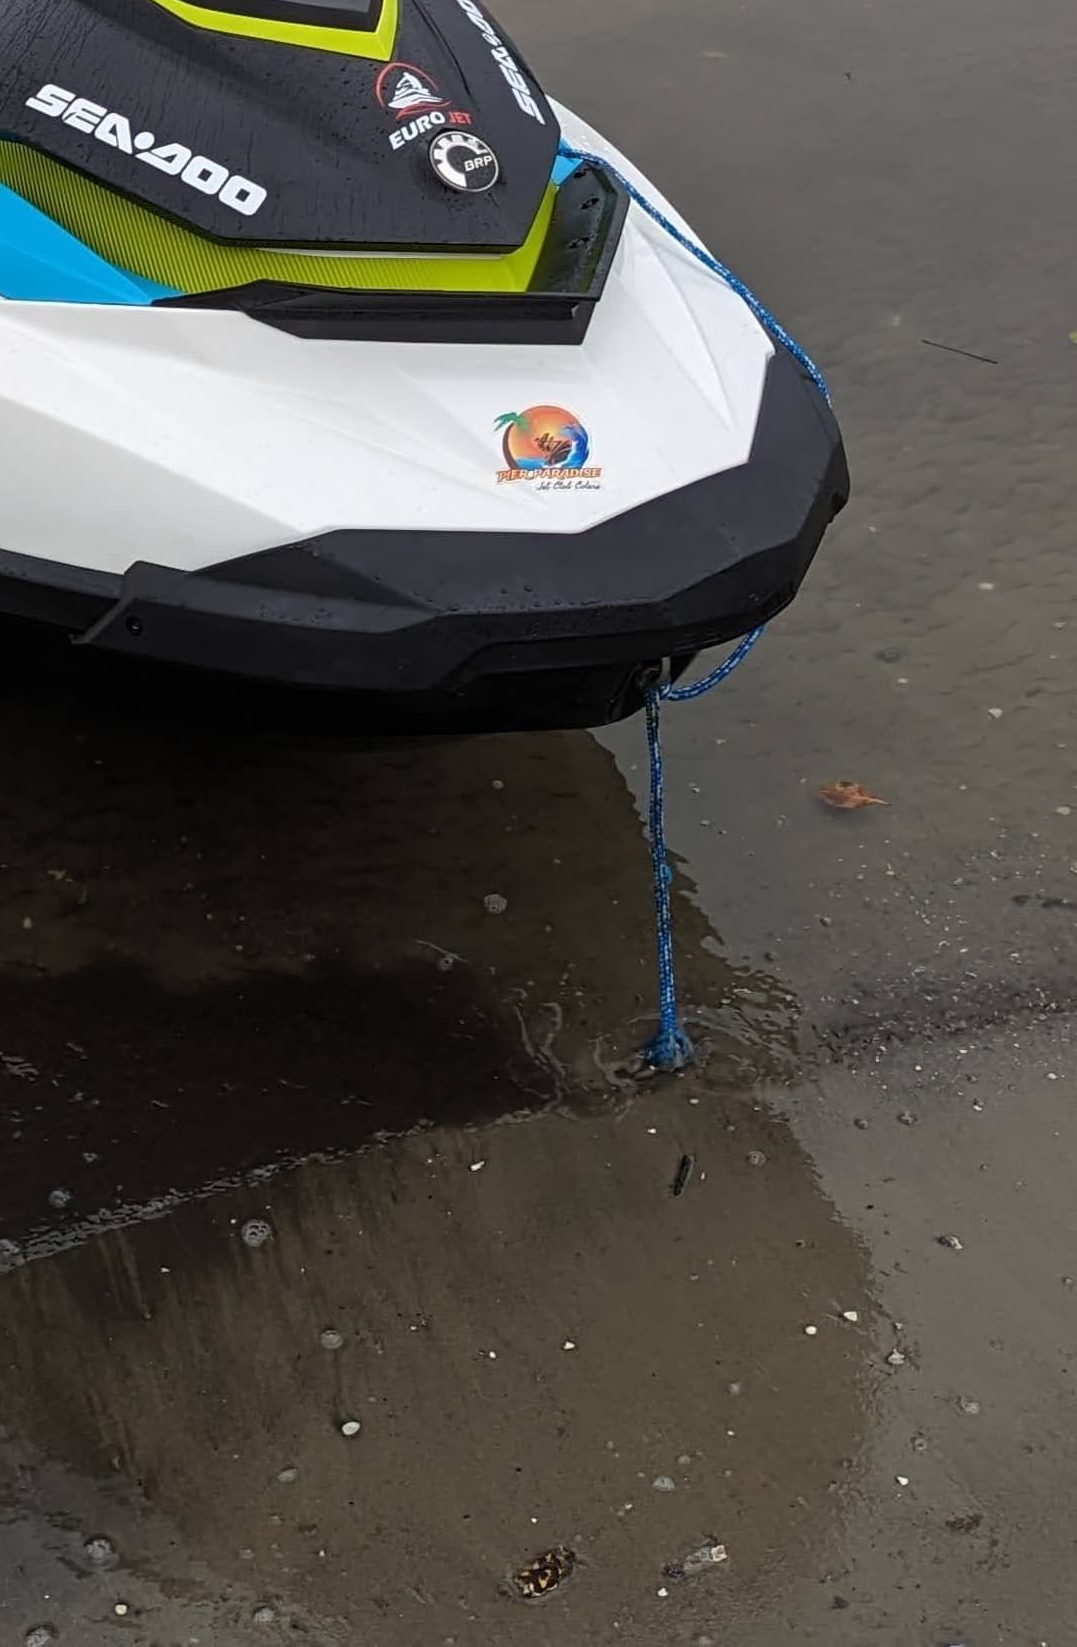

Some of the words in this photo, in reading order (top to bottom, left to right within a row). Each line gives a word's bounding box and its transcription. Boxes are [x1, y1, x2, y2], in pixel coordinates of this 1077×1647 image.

[388, 111, 445, 150] EURO
[448, 111, 472, 124] JET
[464, 155, 493, 172] BRP
[497, 468, 530, 482] PIER
[532, 467, 602, 480] PARADISE
